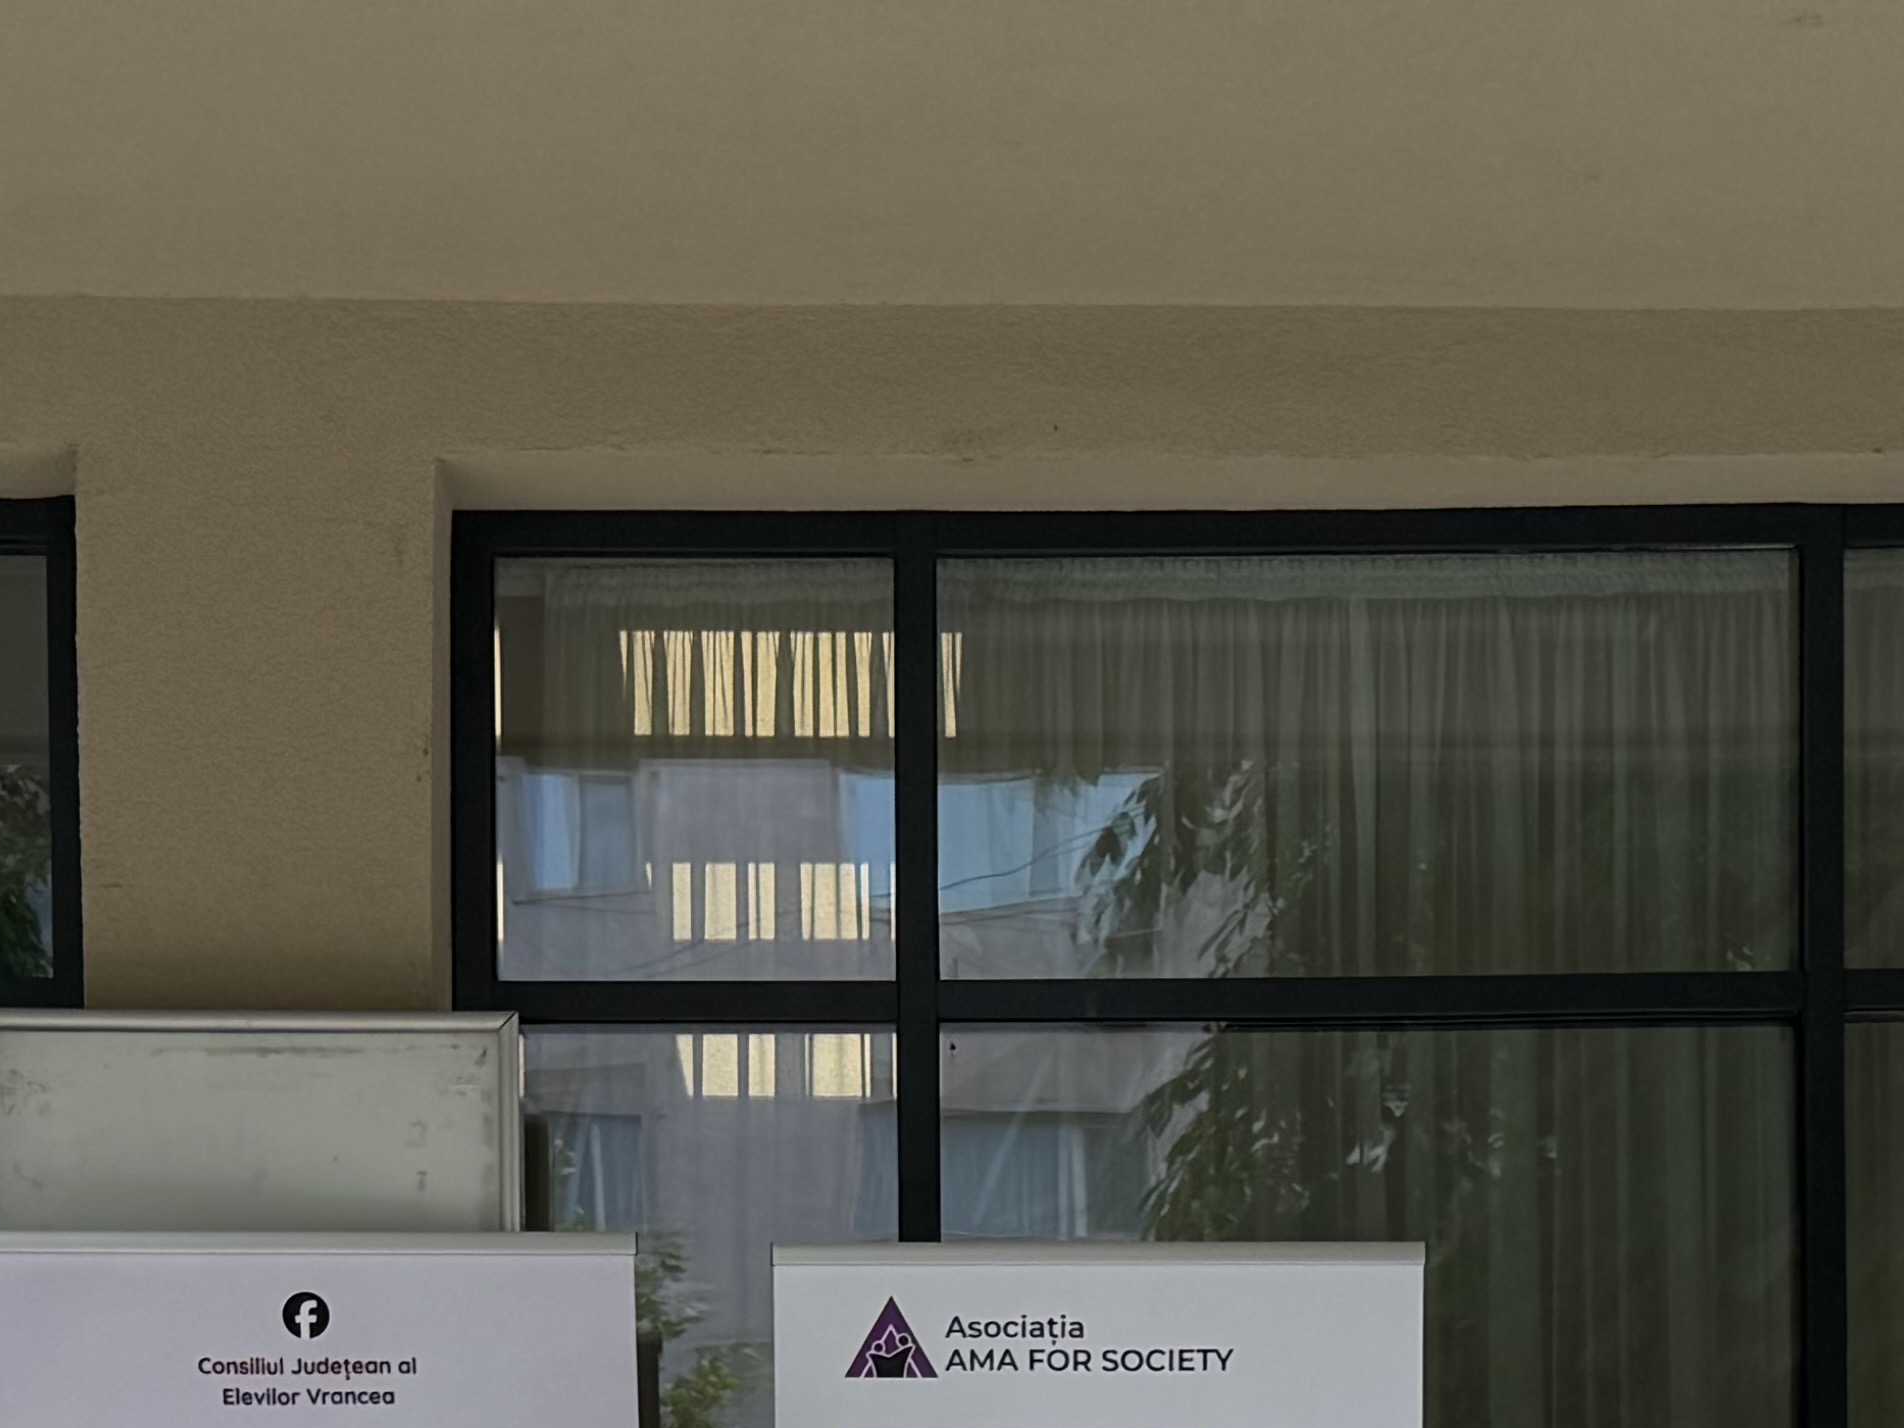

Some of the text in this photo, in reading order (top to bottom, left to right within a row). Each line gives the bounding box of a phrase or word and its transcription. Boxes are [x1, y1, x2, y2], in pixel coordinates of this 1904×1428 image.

[945, 1314, 1085, 1346] Asociația
[197, 1356, 285, 1376] Consiliul
[397, 1356, 418, 1376] al
[945, 1348, 1235, 1373] AMA FOR SOCIETY
[221, 1387, 396, 1407] Elevilor Vrancea
